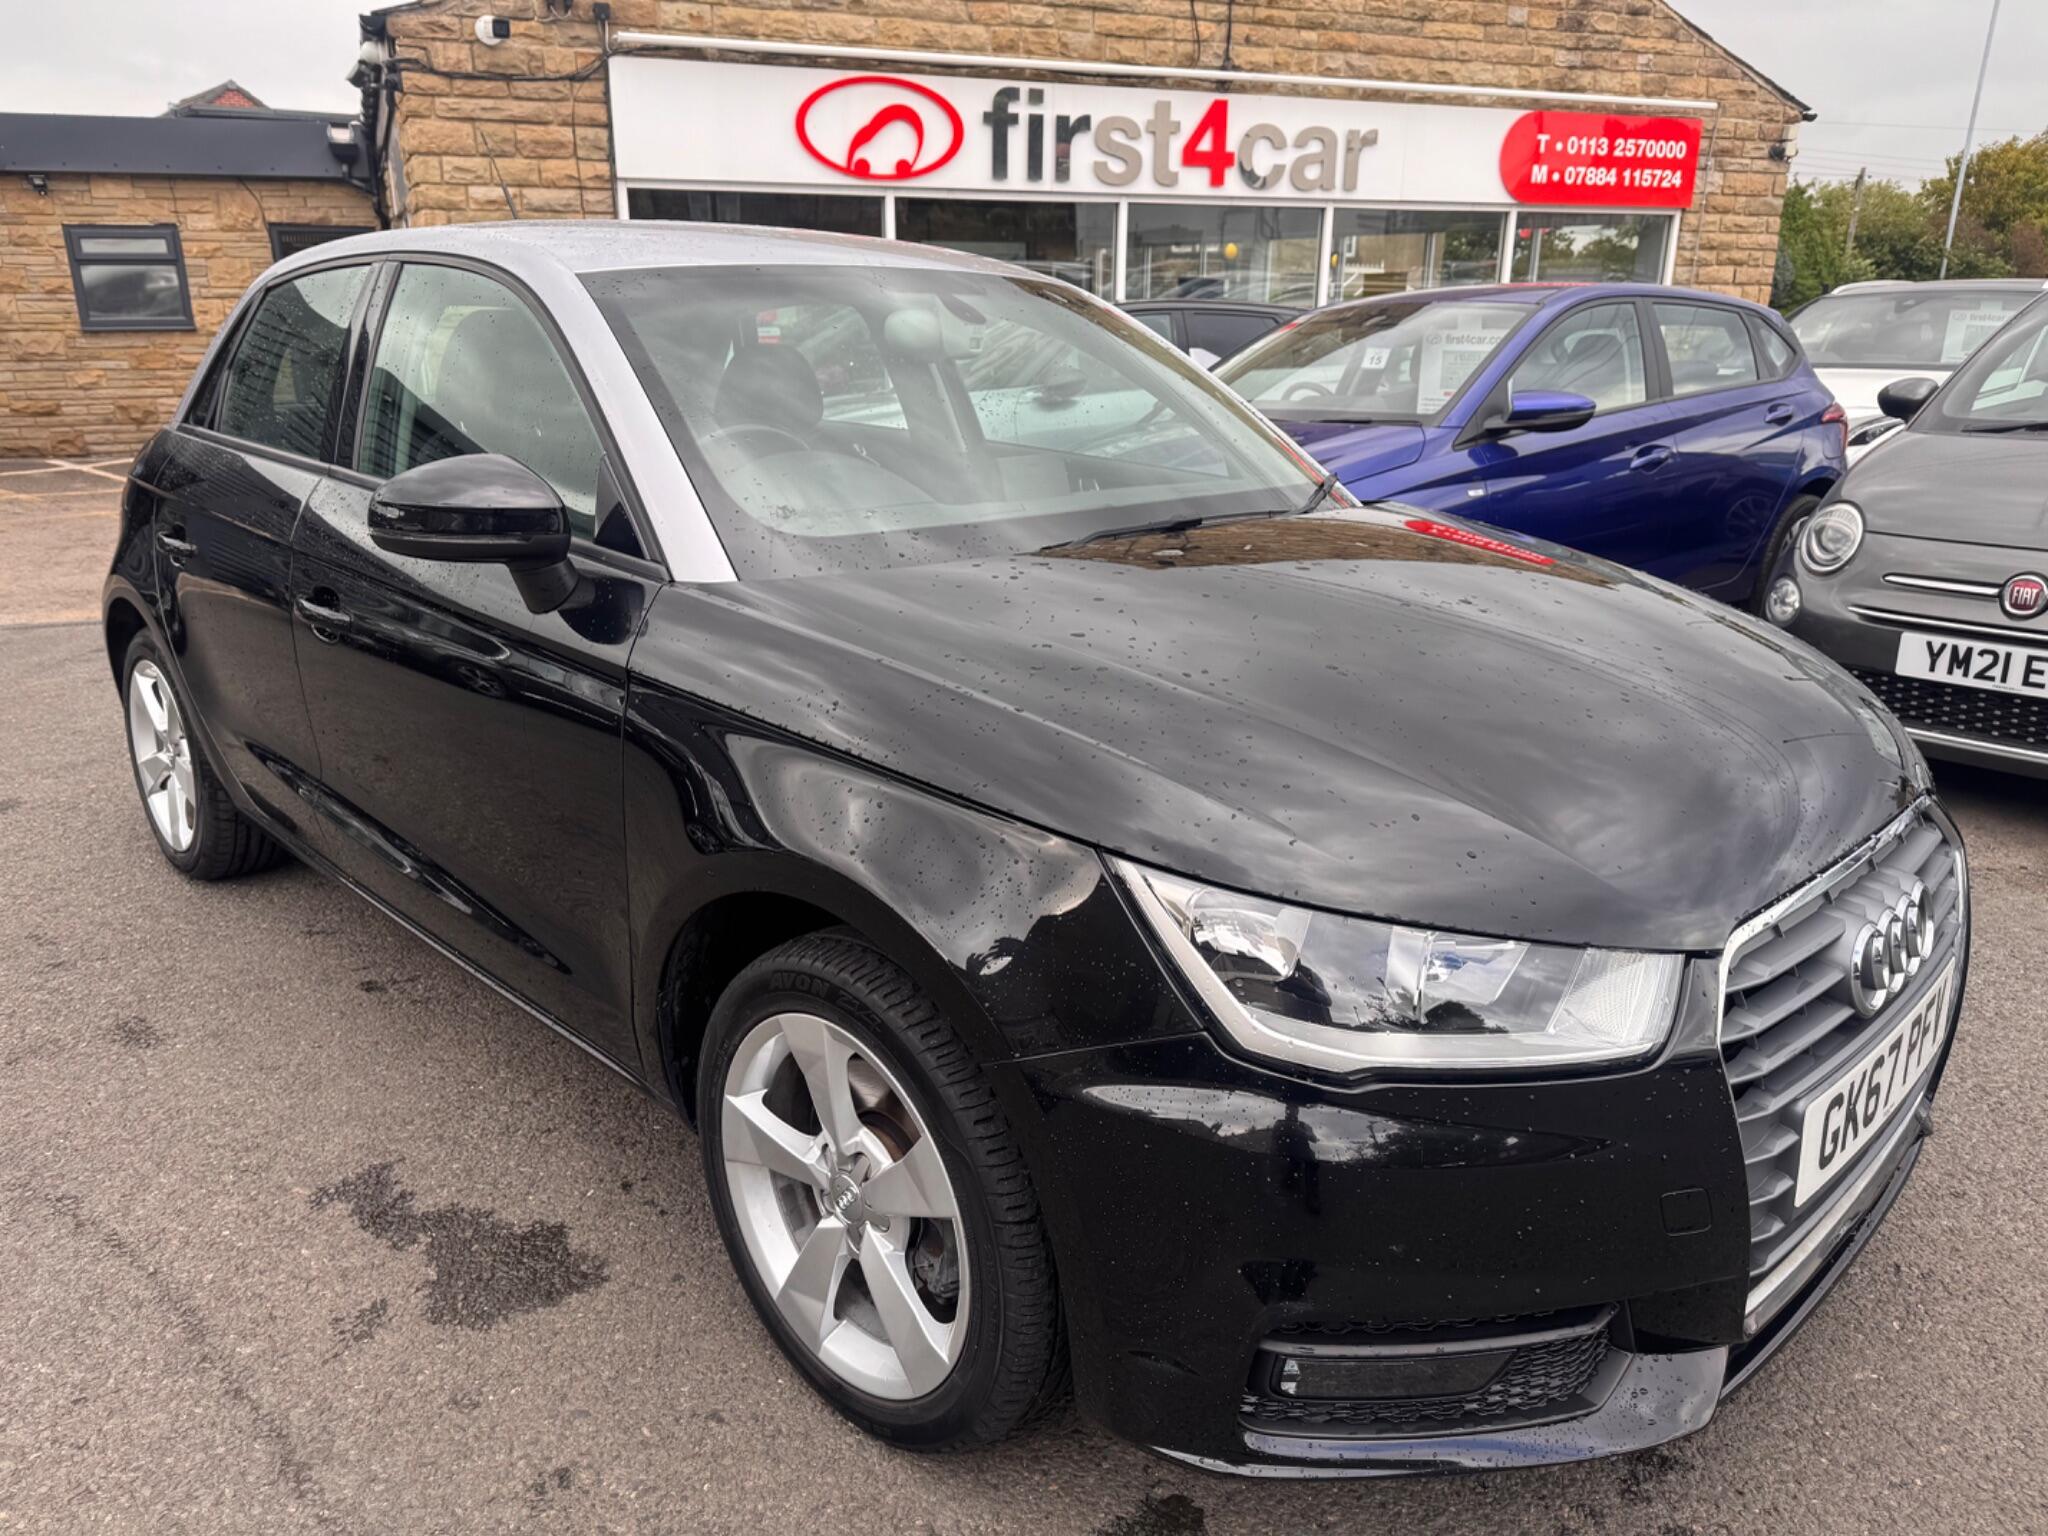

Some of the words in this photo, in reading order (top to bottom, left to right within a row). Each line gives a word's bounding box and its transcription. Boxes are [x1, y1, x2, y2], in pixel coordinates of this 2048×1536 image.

[983, 86, 1379, 192] first4car
[1537, 134, 1550, 154] T
[1567, 136, 1608, 156] 0113
[1613, 138, 1687, 159] 2570000
[1530, 164, 1548, 184] M
[1564, 166, 1617, 186] 07884
[1623, 168, 1682, 188] 115724
[1369, 355, 1382, 365] 15
[2011, 586, 2038, 606] FIAT
[1926, 641, 2012, 684] YM21
[767, 971, 832, 998] AVON
[1818, 1032, 1904, 1170] GK67
